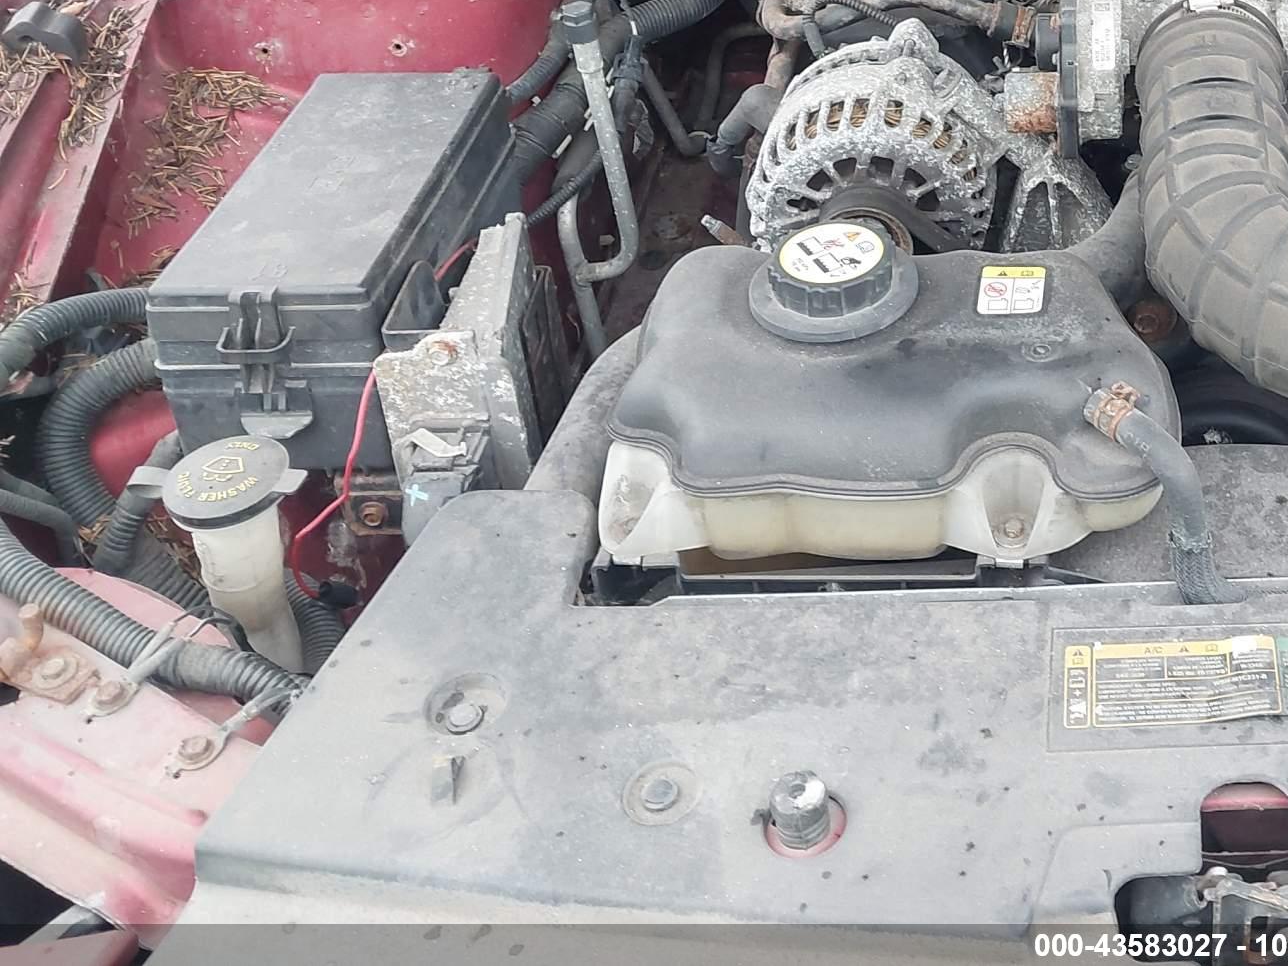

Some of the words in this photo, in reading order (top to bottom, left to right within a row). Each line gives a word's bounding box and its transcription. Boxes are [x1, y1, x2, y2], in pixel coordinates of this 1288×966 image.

[225, 441, 260, 451] ONLY
[197, 476, 258, 502] WASHER
[1143, 646, 1163, 655] A/C
